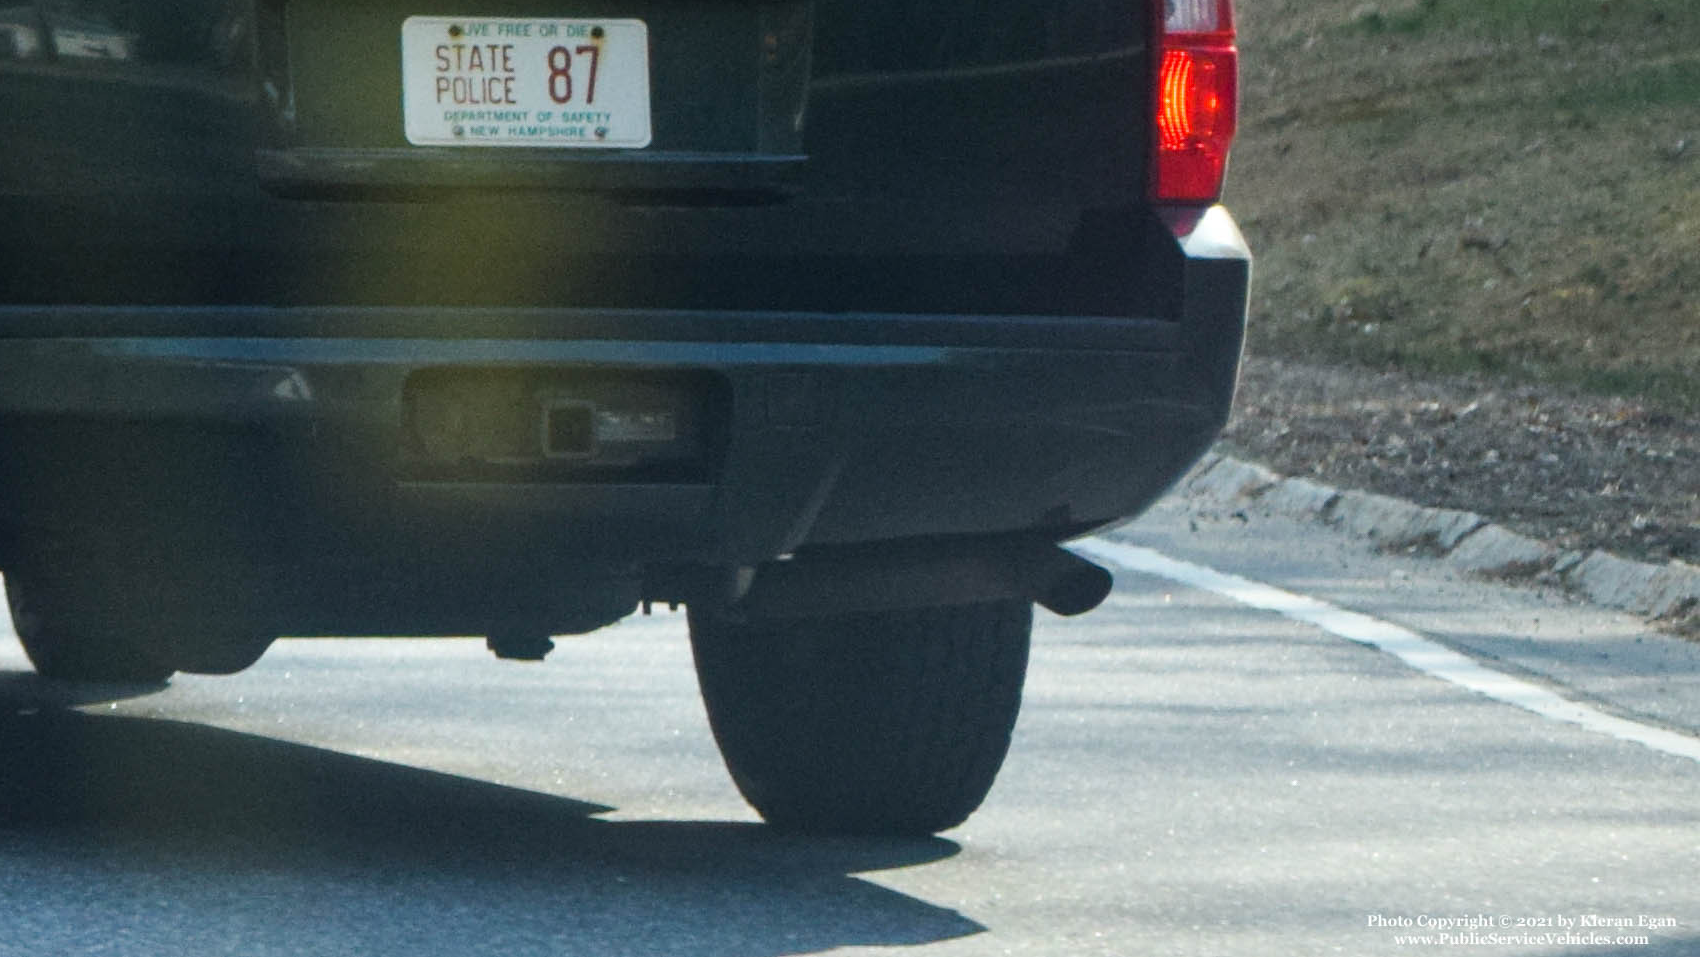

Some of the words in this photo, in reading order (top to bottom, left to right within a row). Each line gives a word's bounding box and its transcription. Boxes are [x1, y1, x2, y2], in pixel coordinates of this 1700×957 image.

[498, 23, 532, 37] FREE
[539, 23, 557, 37] OR
[566, 24, 589, 38] DIE
[436, 45, 515, 73] STATE
[547, 45, 600, 104] 87
[436, 77, 517, 104] POLICE
[444, 111, 528, 123] DEPARTMENT
[536, 112, 553, 123] OF
[562, 112, 612, 124] SAFETY
[470, 126, 500, 137] NEW
[508, 126, 586, 138] HAMPSHIRE
